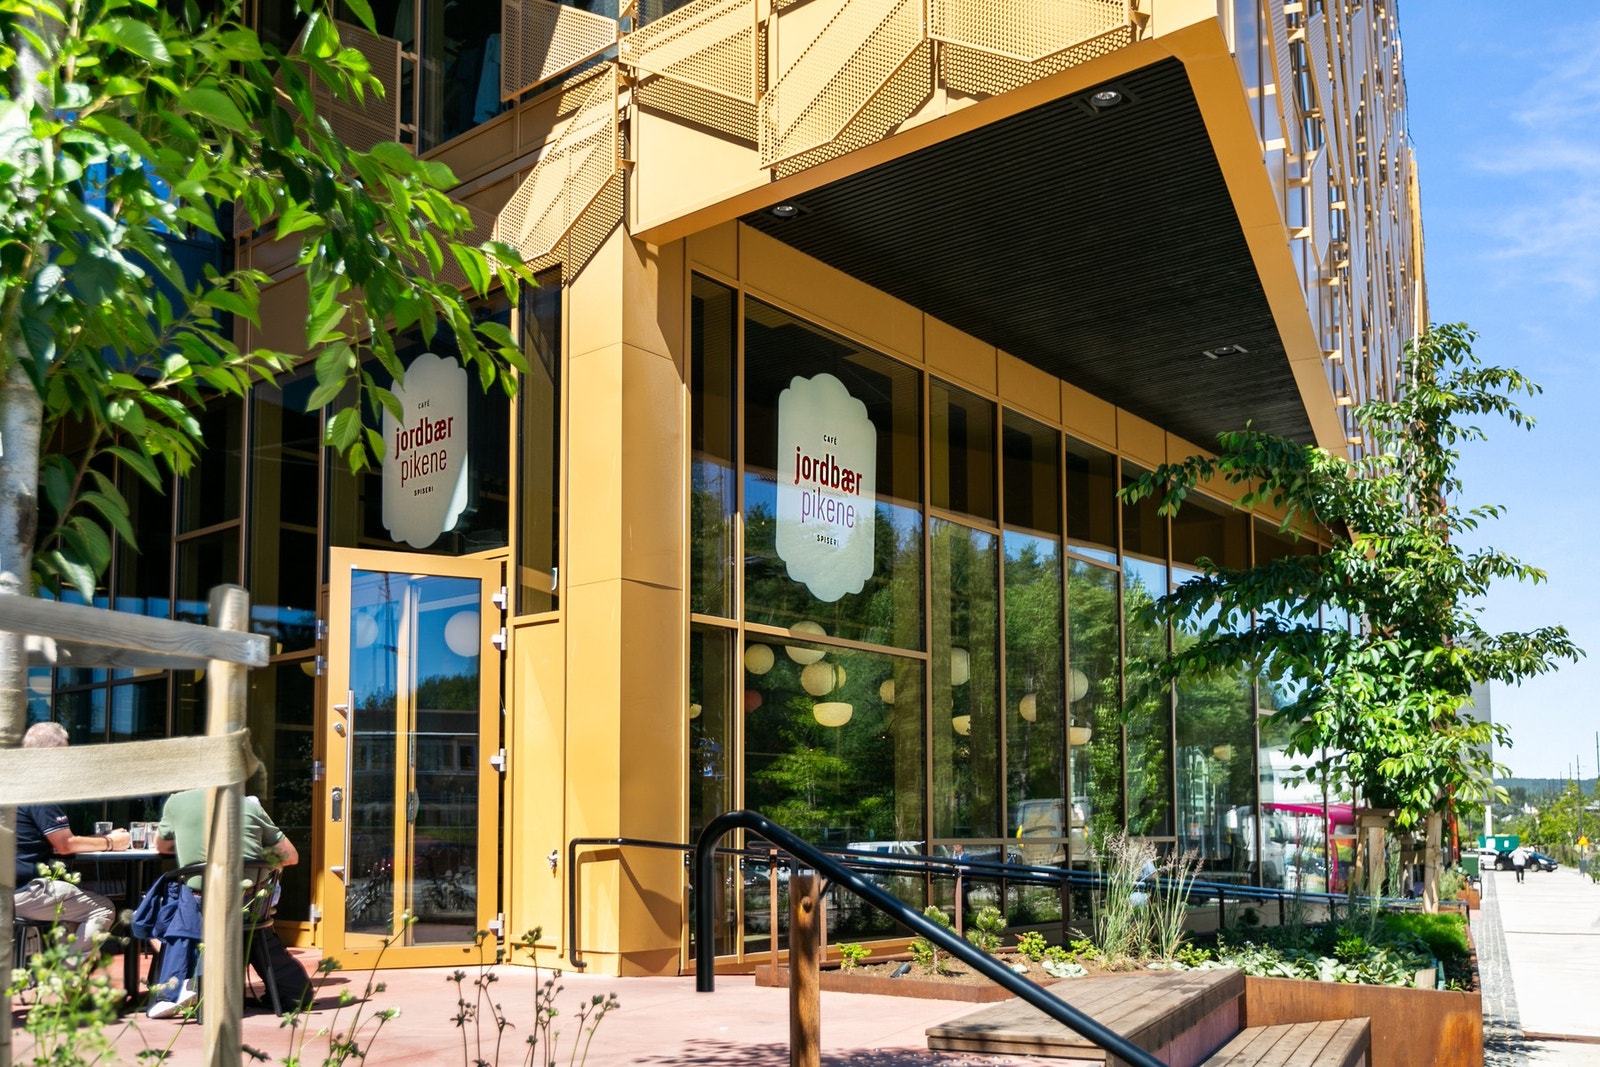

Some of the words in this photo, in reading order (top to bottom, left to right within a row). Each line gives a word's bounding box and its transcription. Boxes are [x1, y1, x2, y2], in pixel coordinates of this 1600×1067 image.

[418, 398, 430, 409] CAFÉ
[395, 416, 453, 460] jordbær
[823, 435, 837, 445] CAFÉ
[401, 449, 447, 488] pikene
[795, 446, 862, 495] jordbær
[414, 485, 434, 496] SPISERI
[802, 487, 854, 528] pikene
